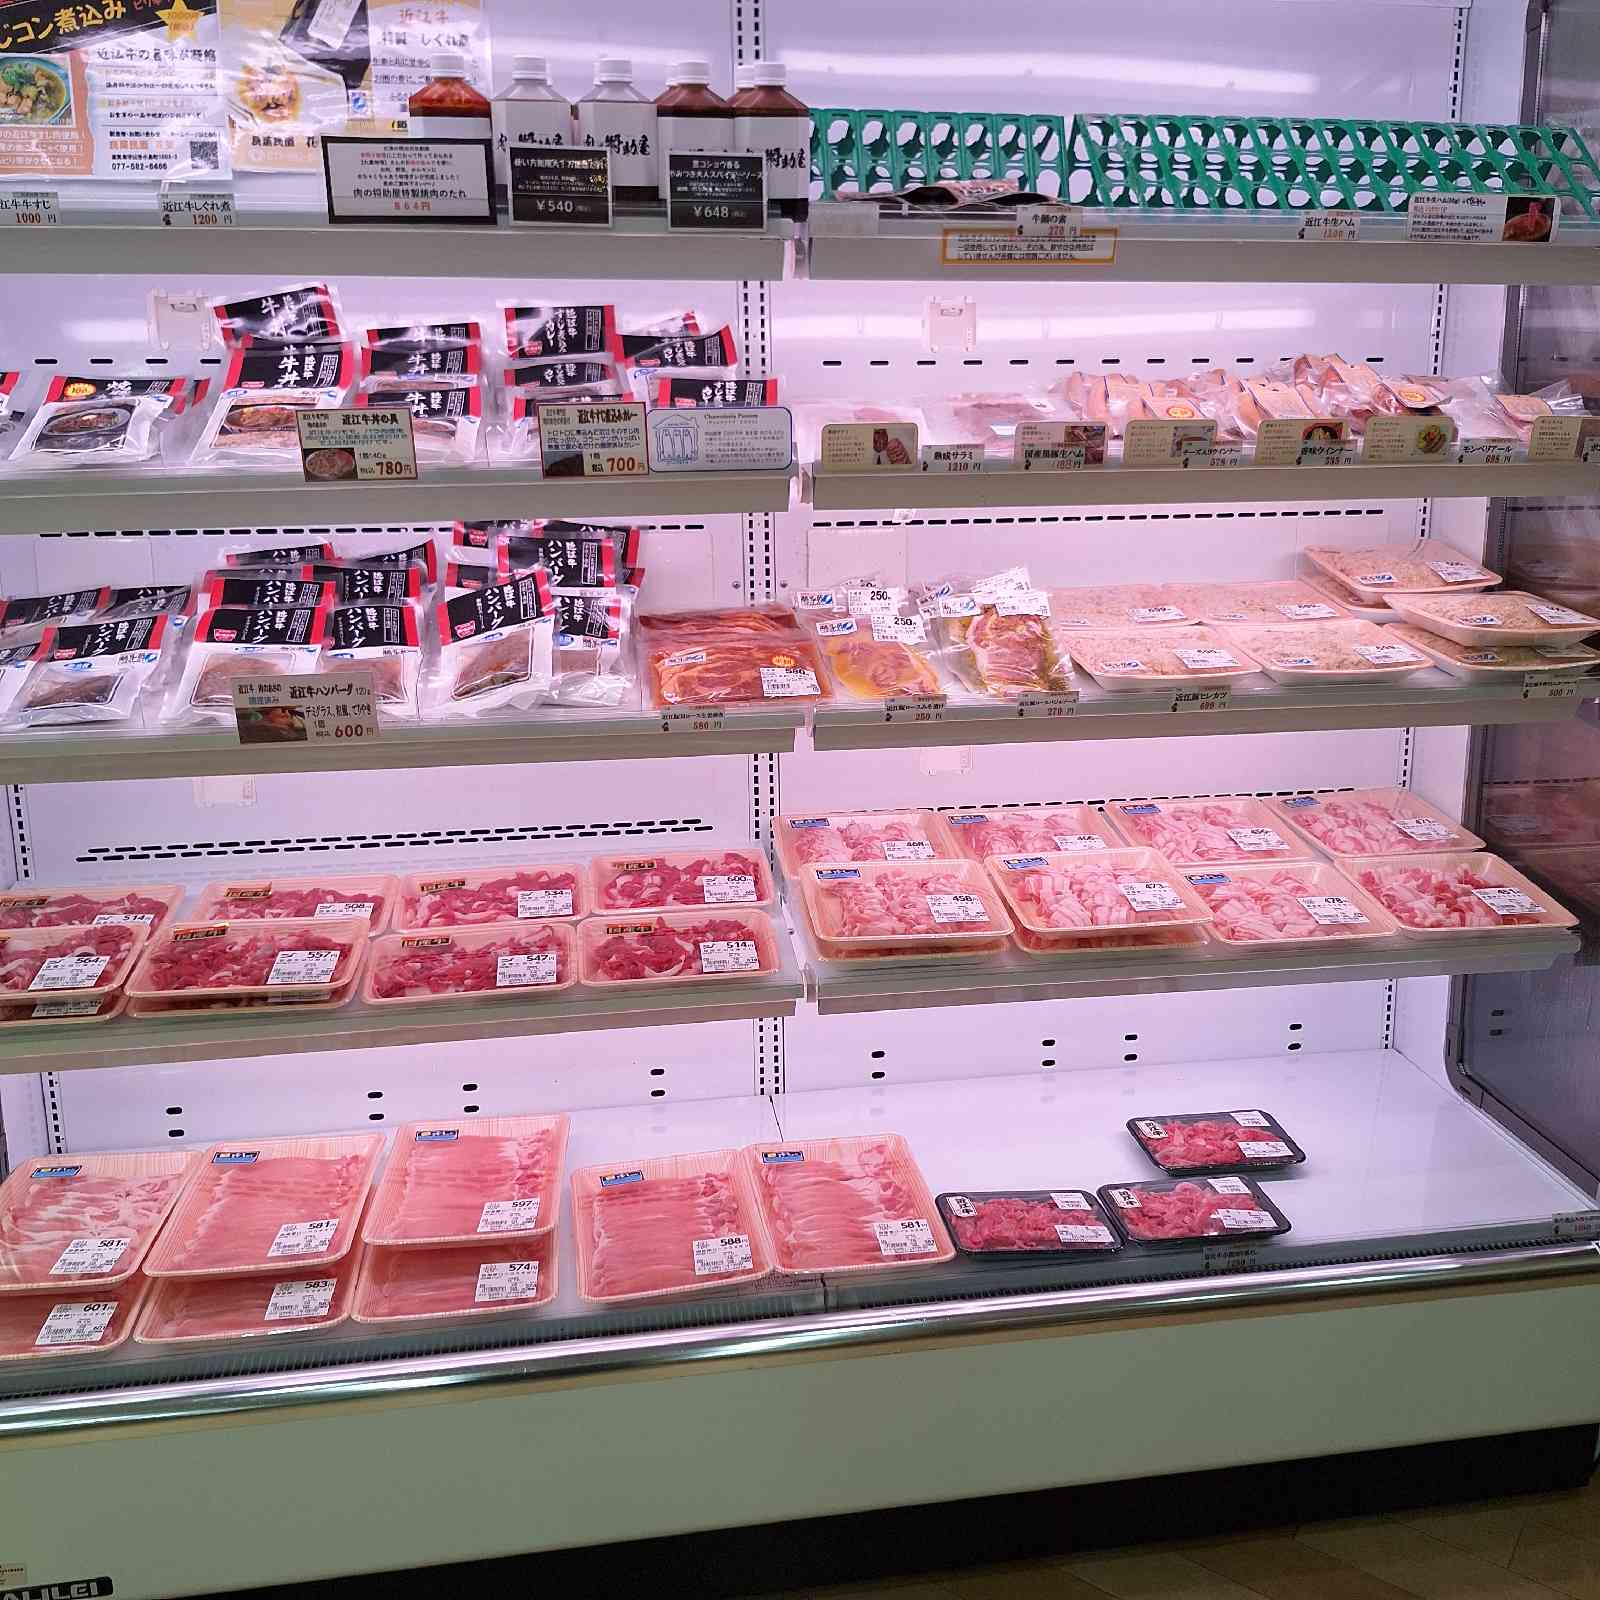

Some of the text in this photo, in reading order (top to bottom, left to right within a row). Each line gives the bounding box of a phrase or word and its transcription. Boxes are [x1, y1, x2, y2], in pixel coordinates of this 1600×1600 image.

[162, 200, 231, 212] 近江牛しぐれ煮
[342, 413, 399, 425] 近江牛丼の具
[934, 451, 974, 461] 熟成サラミ
[548, 540, 565, 587] ハンバーグ
[485, 587, 505, 630] ハンバーグ
[253, 610, 272, 644] ハンバーグ
[348, 607, 367, 647] ハンバーグ
[290, 684, 354, 699] 近江牛ハンバーグ
